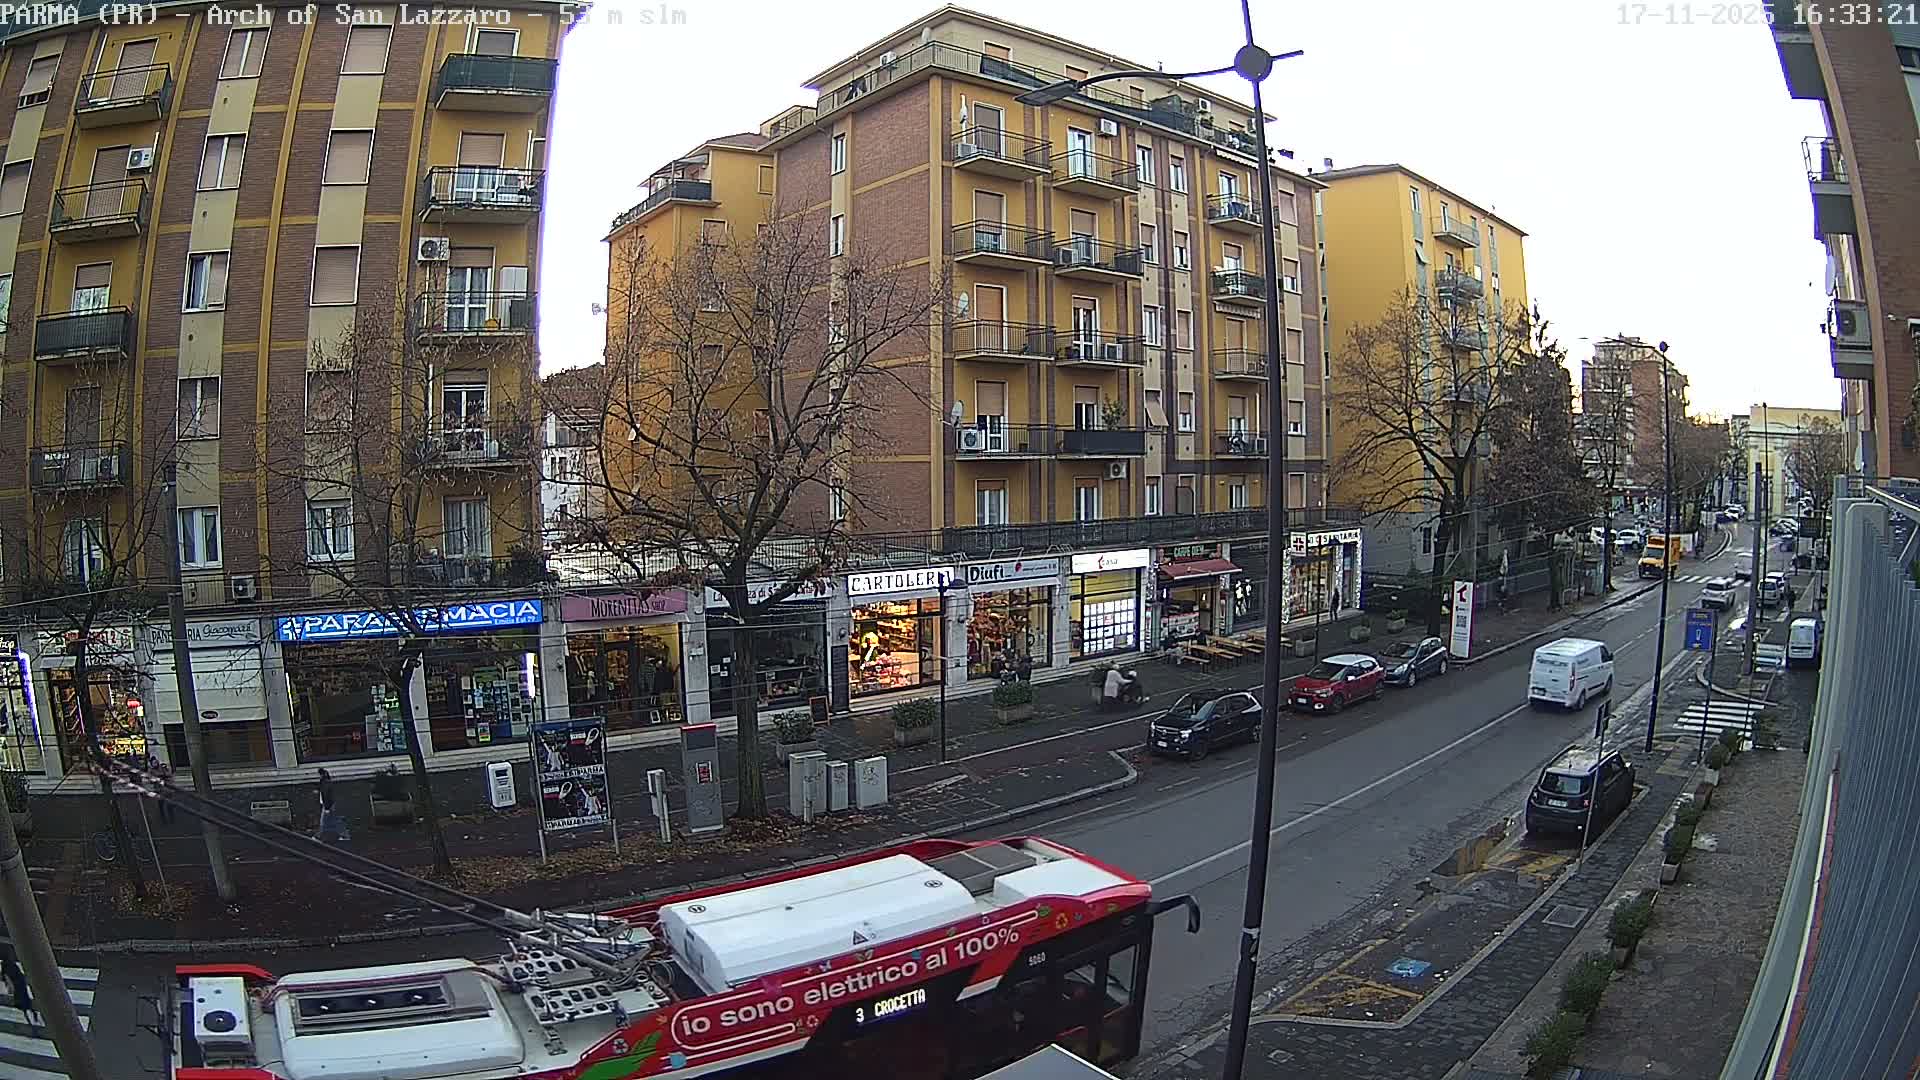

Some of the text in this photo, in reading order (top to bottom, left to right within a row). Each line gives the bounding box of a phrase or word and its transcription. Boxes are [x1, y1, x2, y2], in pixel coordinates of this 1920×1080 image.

[303, 601, 538, 632] PARARMACIA
[591, 597, 650, 618] MORENITAS
[152, 628, 202, 643] PANERIA
[681, 928, 1019, 1036] io sono elettrico al 100%
[855, 988, 926, 1023] 3 CROCETTA
